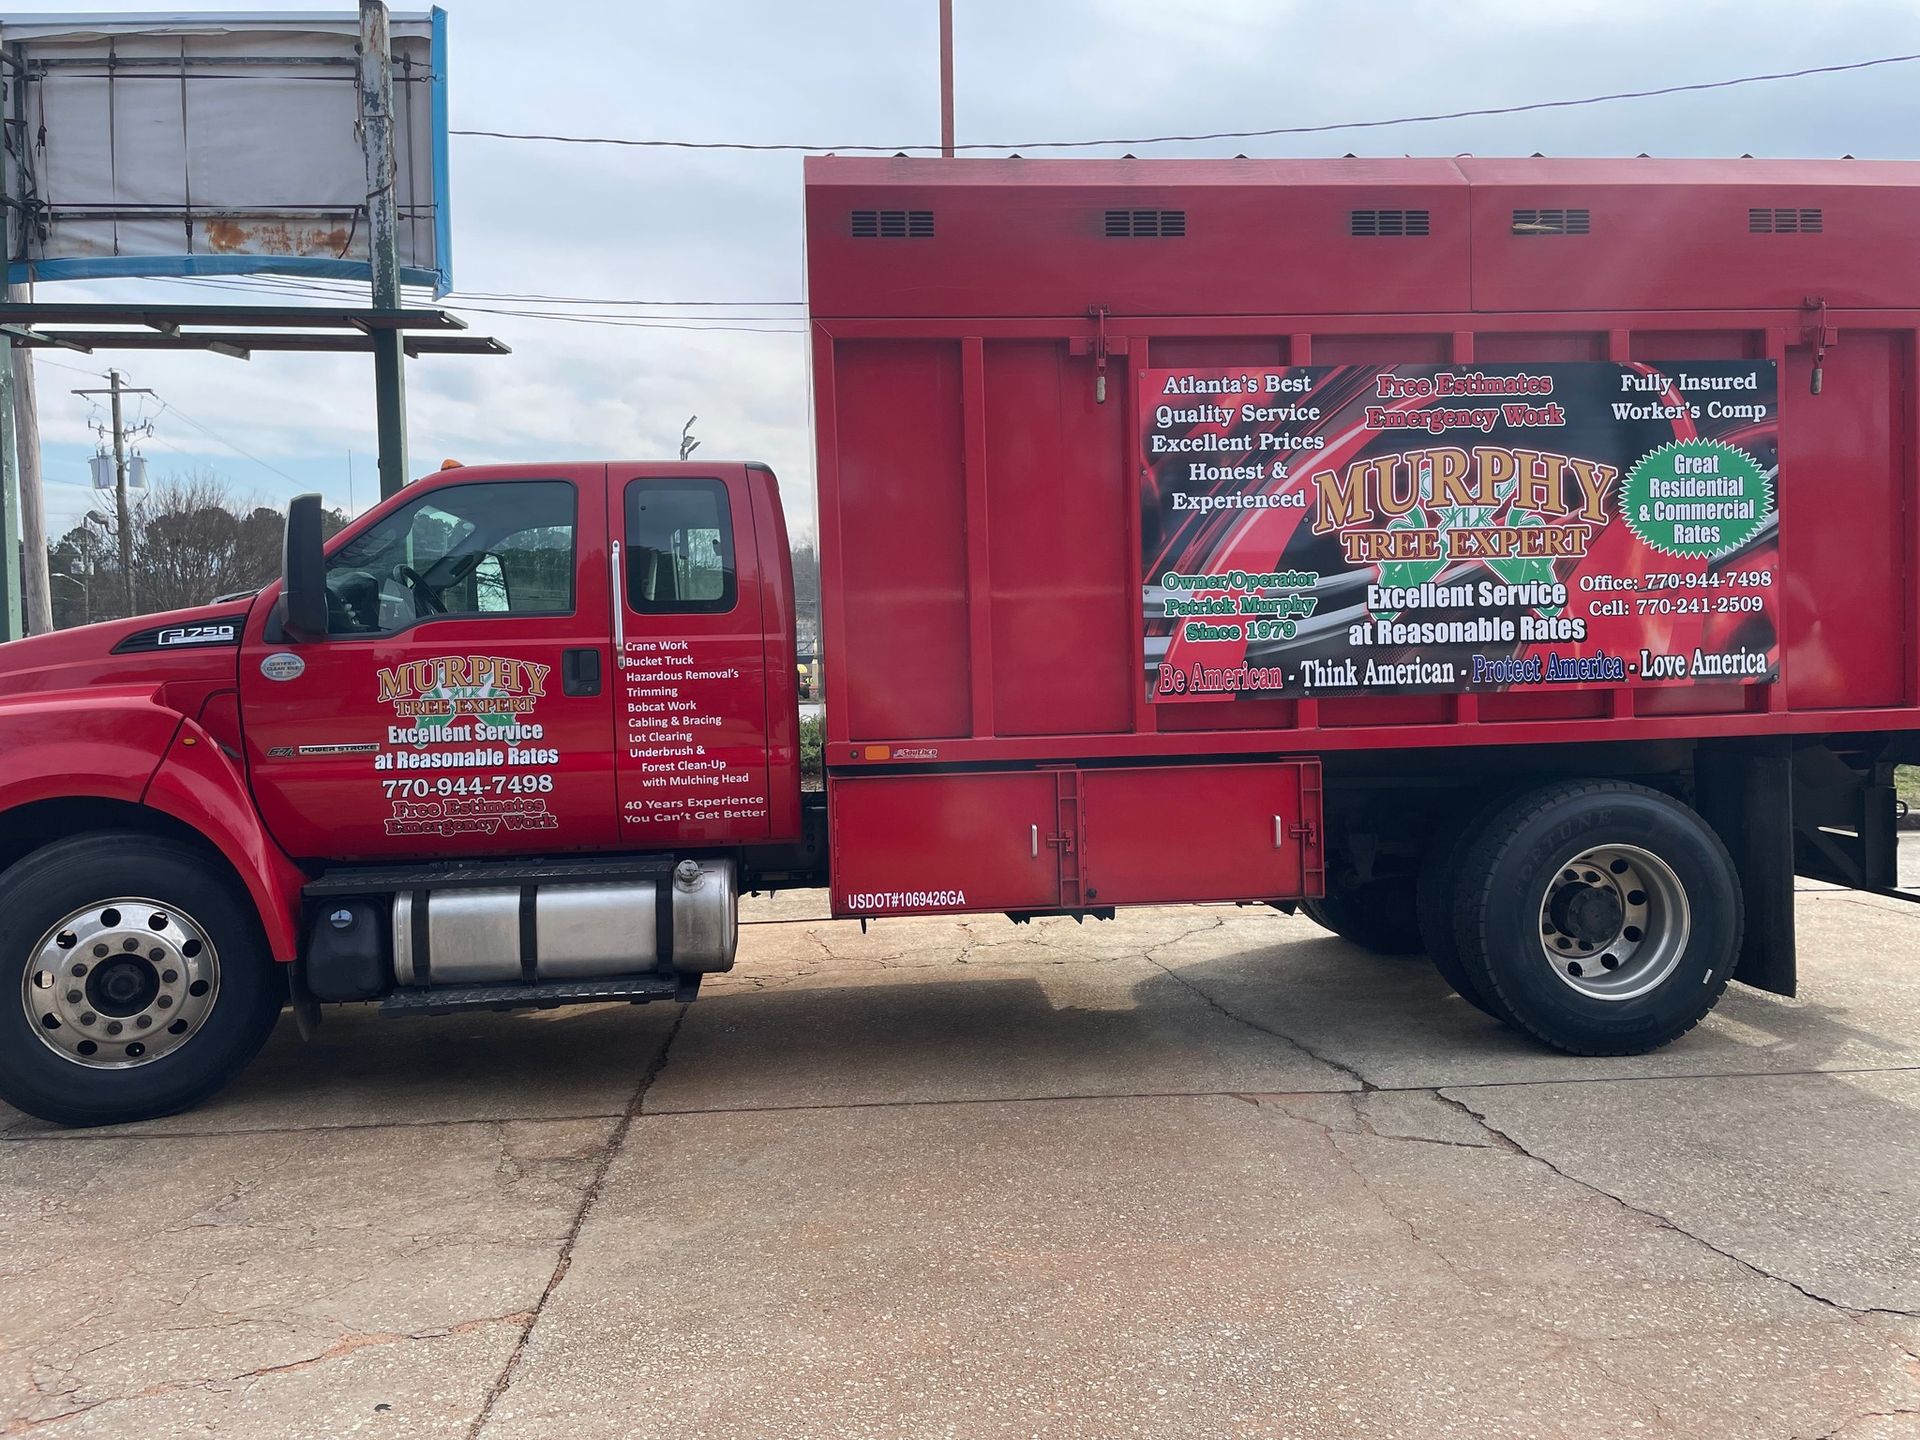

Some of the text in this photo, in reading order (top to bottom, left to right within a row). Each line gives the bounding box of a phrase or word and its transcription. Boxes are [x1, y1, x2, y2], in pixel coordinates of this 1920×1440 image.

[1163, 374, 1312, 394] Atlanta's Best
[1376, 372, 1553, 398] Free Estimates
[1620, 372, 1758, 396] Fully Insured
[1156, 403, 1320, 428] Quality Service
[1365, 402, 1565, 434] Emergency Work
[1611, 401, 1767, 424] Worker's Comp
[1151, 432, 1324, 453] Excellent Prices
[1189, 462, 1288, 481] Honest &
[1674, 454, 1719, 475] Great
[1312, 446, 1618, 534] MURPHY
[1649, 477, 1744, 499] Residential
[1172, 490, 1306, 514] Experienced
[1638, 499, 1755, 522] & Commercial
[1341, 525, 1591, 562] TREE EXPERT
[1674, 524, 1721, 545] Rates
[1161, 569, 1319, 592] Owner/Operator
[1580, 571, 1772, 593] Office: 770-944-7498
[1164, 595, 1317, 618] Patrick Murphy
[1367, 581, 1567, 610] Excellent Service
[1588, 596, 1763, 617] Cell: 770-241-2509
[1185, 619, 1298, 643] Since 1979
[1348, 616, 1586, 647] at Reasonable Rates
[625, 640, 688, 651] Crane Work
[626, 655, 694, 666] Bucket Truck
[1158, 663, 1186, 693] Be
[1189, 661, 1284, 691] American
[1300, 658, 1359, 688] Think
[1362, 656, 1455, 686] American
[1472, 653, 1541, 683] Protect
[1545, 650, 1625, 682] America
[1640, 648, 1686, 678] Love
[1690, 645, 1767, 675] America
[377, 655, 551, 703] MURPHY
[626, 668, 739, 682] Hazardous Removal's
[627, 686, 678, 698] Trimming
[395, 696, 536, 718] TREE EXPERT
[628, 701, 696, 712] Bobcat Work
[628, 715, 722, 728] Cabling & Bracing
[388, 722, 544, 745] Excellent Service
[629, 731, 693, 743] Lot Clearing
[374, 747, 559, 770] at Reasonable Rates
[630, 745, 705, 758] Underbrush &
[642, 759, 726, 772] Forest Clean-Up
[382, 775, 553, 798] 770-944-7498
[642, 773, 749, 787] with Mulching Head
[392, 797, 546, 819] Free Estimates
[624, 796, 764, 810] 40 Years Experience
[384, 813, 559, 837] Emergency Work
[624, 808, 767, 824] You Can't Get Better
[848, 890, 966, 909] USDOT#1069426GA
